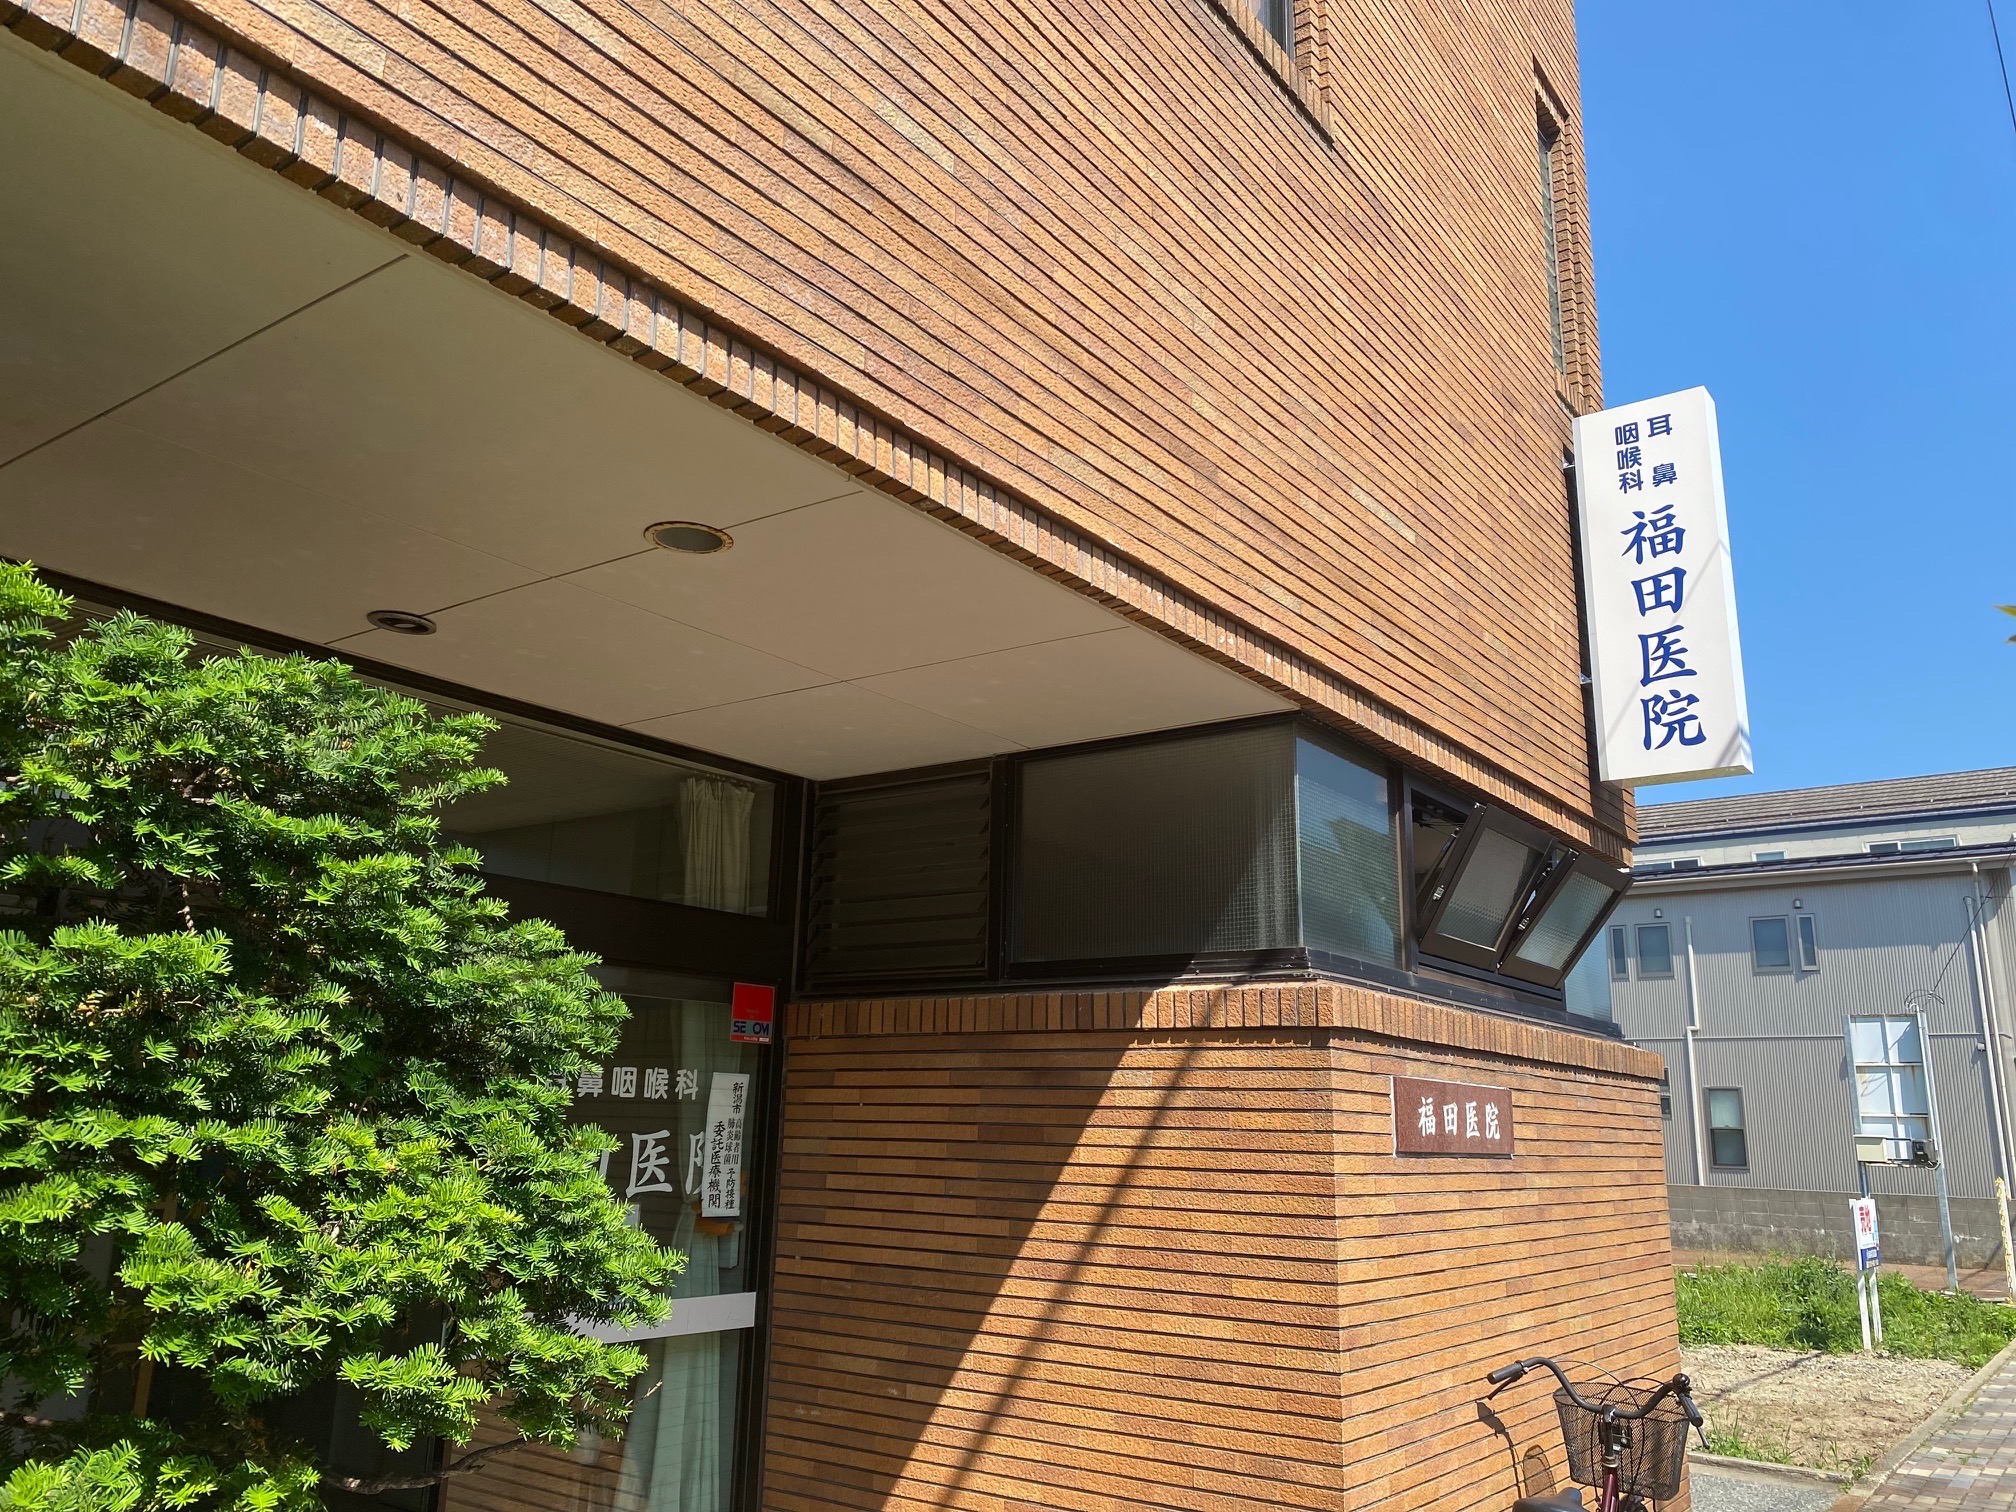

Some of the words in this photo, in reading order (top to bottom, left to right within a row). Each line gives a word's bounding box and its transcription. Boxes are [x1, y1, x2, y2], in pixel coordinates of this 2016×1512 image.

[1614, 421, 1644, 494] 咽喉科
[1647, 413, 1678, 488] 耳鼻
[1620, 503, 1707, 751] 福田医院
[732, 1081, 745, 1114] 新潟市
[1417, 1096, 1501, 1140] 福田医院
[707, 1120, 726, 1209] 委託医療機関
[723, 1168, 736, 1210] 予防接種
